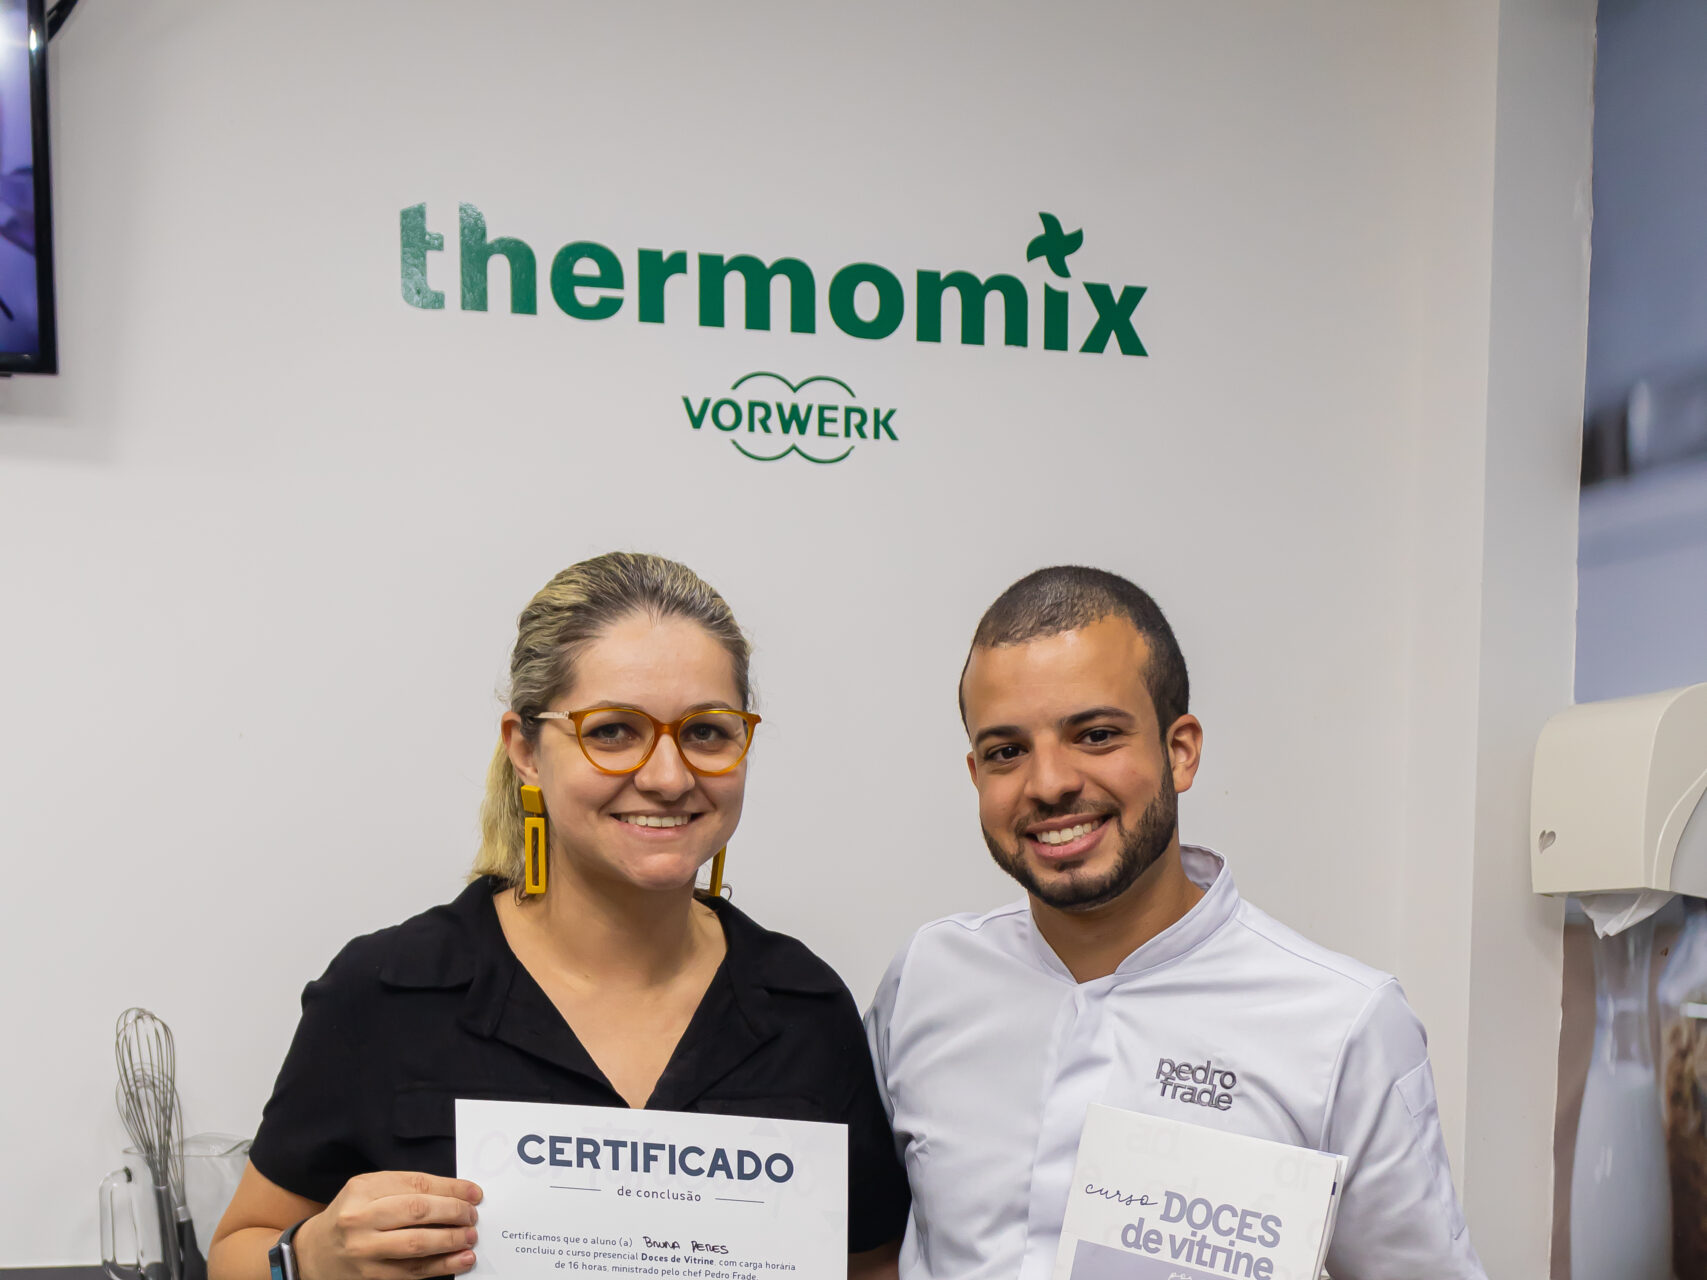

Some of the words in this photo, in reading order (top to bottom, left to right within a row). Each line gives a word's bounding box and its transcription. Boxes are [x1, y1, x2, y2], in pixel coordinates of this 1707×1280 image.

[400, 201, 1149, 357] thermomix
[682, 396, 899, 442] VORWERK
[1155, 1057, 1237, 1090] pedro
[1159, 1075, 1233, 1111] frade
[516, 1133, 794, 1184] CERTIFICADO
[617, 1185, 632, 1197] de
[636, 1188, 702, 1202] conclusão
[1085, 1183, 1158, 1206] curso
[1159, 1190, 1283, 1249] DOCES
[501, 1230, 561, 1243] Certificamos
[563, 1236, 581, 1247] que
[590, 1236, 617, 1246] aluno
[1121, 1217, 1163, 1255] de
[515, 1245, 556, 1256] concluiu
[558, 1248, 564, 1256] o
[566, 1249, 591, 1258] curso
[593, 1251, 639, 1261] presencial
[641, 1252, 668, 1263] Doces
[670, 1254, 681, 1264] de
[719, 1259, 737, 1267] com
[739, 1260, 763, 1271] carga
[765, 1260, 796, 1271] horária
[554, 1261, 566, 1270] de
[568, 1261, 579, 1270] 16
[612, 1265, 659, 1276] ministrado
[661, 1267, 680, 1277] pelo
[682, 1267, 702, 1277] chef
[704, 1269, 730, 1280] Pedro
